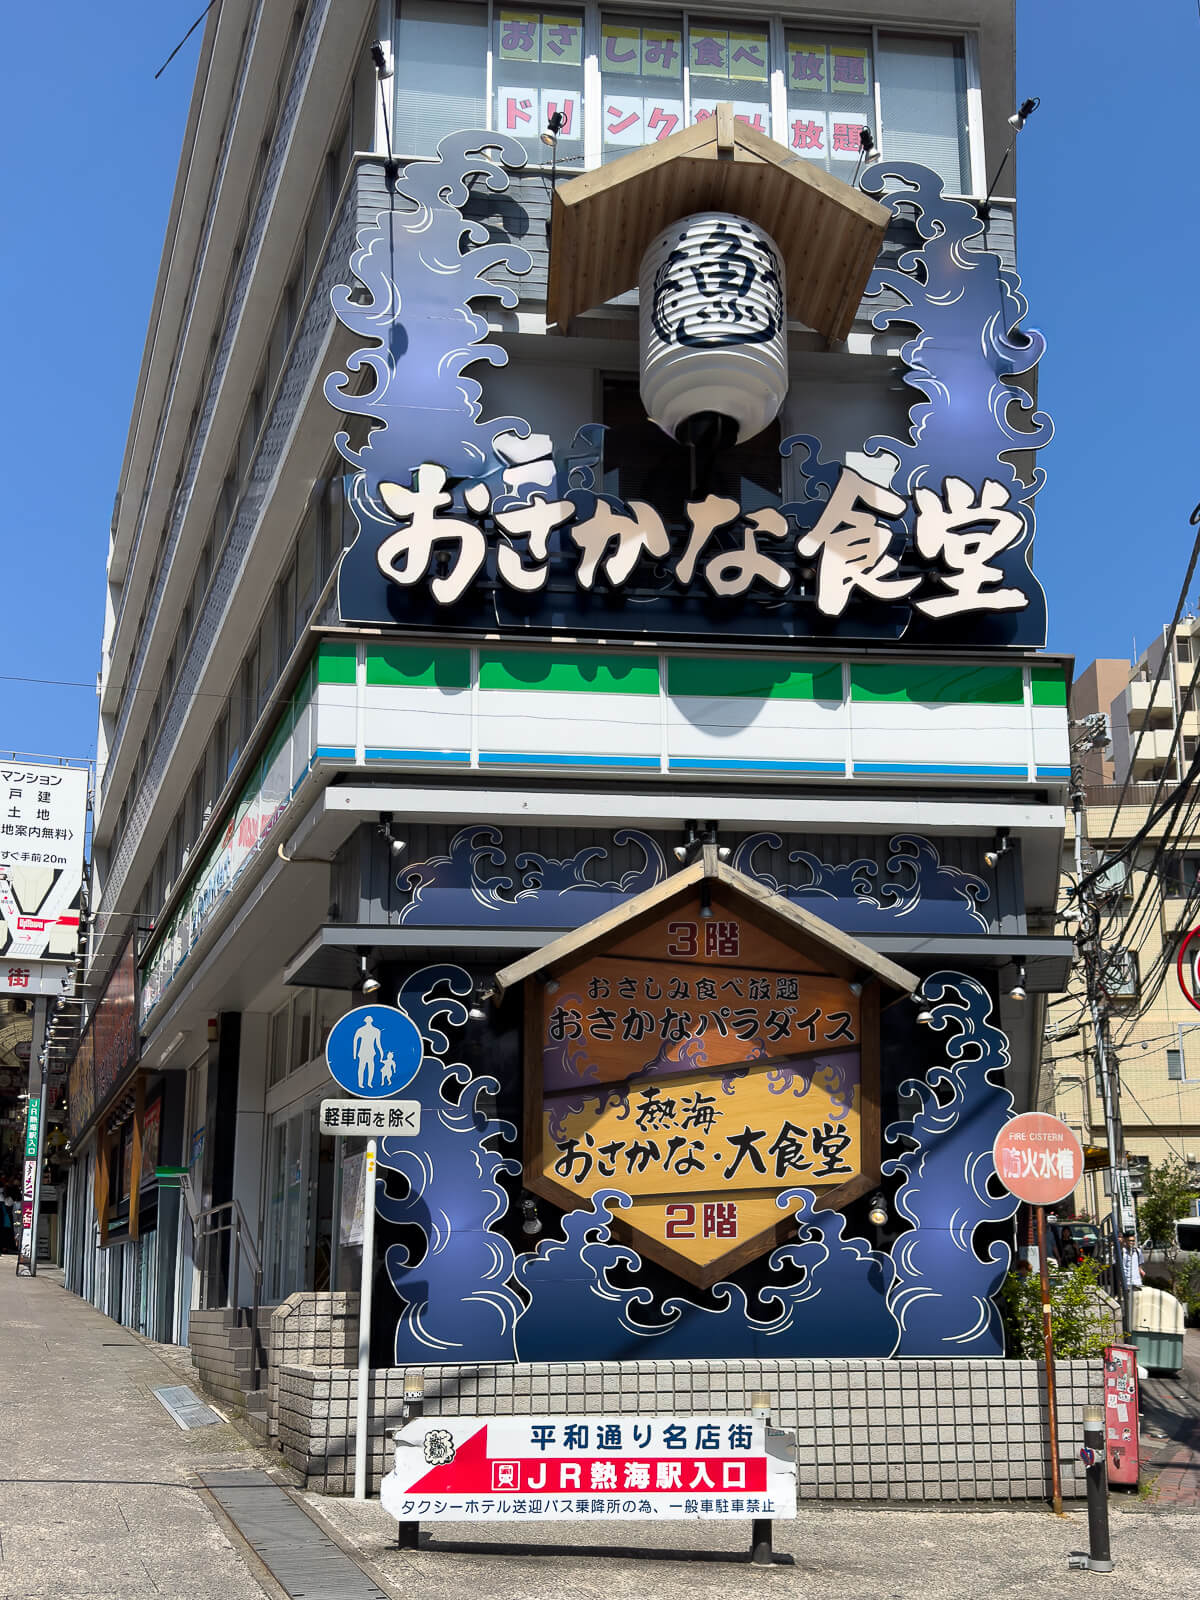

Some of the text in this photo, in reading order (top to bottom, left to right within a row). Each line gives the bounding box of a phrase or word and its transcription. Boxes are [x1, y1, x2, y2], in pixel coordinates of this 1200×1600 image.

[501, 20, 866, 85] おさしみ食べ放題
[376, 462, 1029, 618] おさかな食堂
[0, 770, 63, 786] マンション
[667, 921, 739, 957] 3階
[8, 967, 30, 987] 街
[587, 976, 801, 1001] おさしみ食べ放題
[549, 1006, 856, 1041] おさかなパラダイス
[323, 1107, 416, 1128] 軽車両を除く
[635, 1086, 724, 1134] 熱海
[1009, 1132, 1064, 1142] FIRE CISTERN
[665, 1202, 737, 1239] 2階
[531, 1423, 753, 1450] 平和通り名店街
[528, 1460, 747, 1490] JR熱海駅入口
